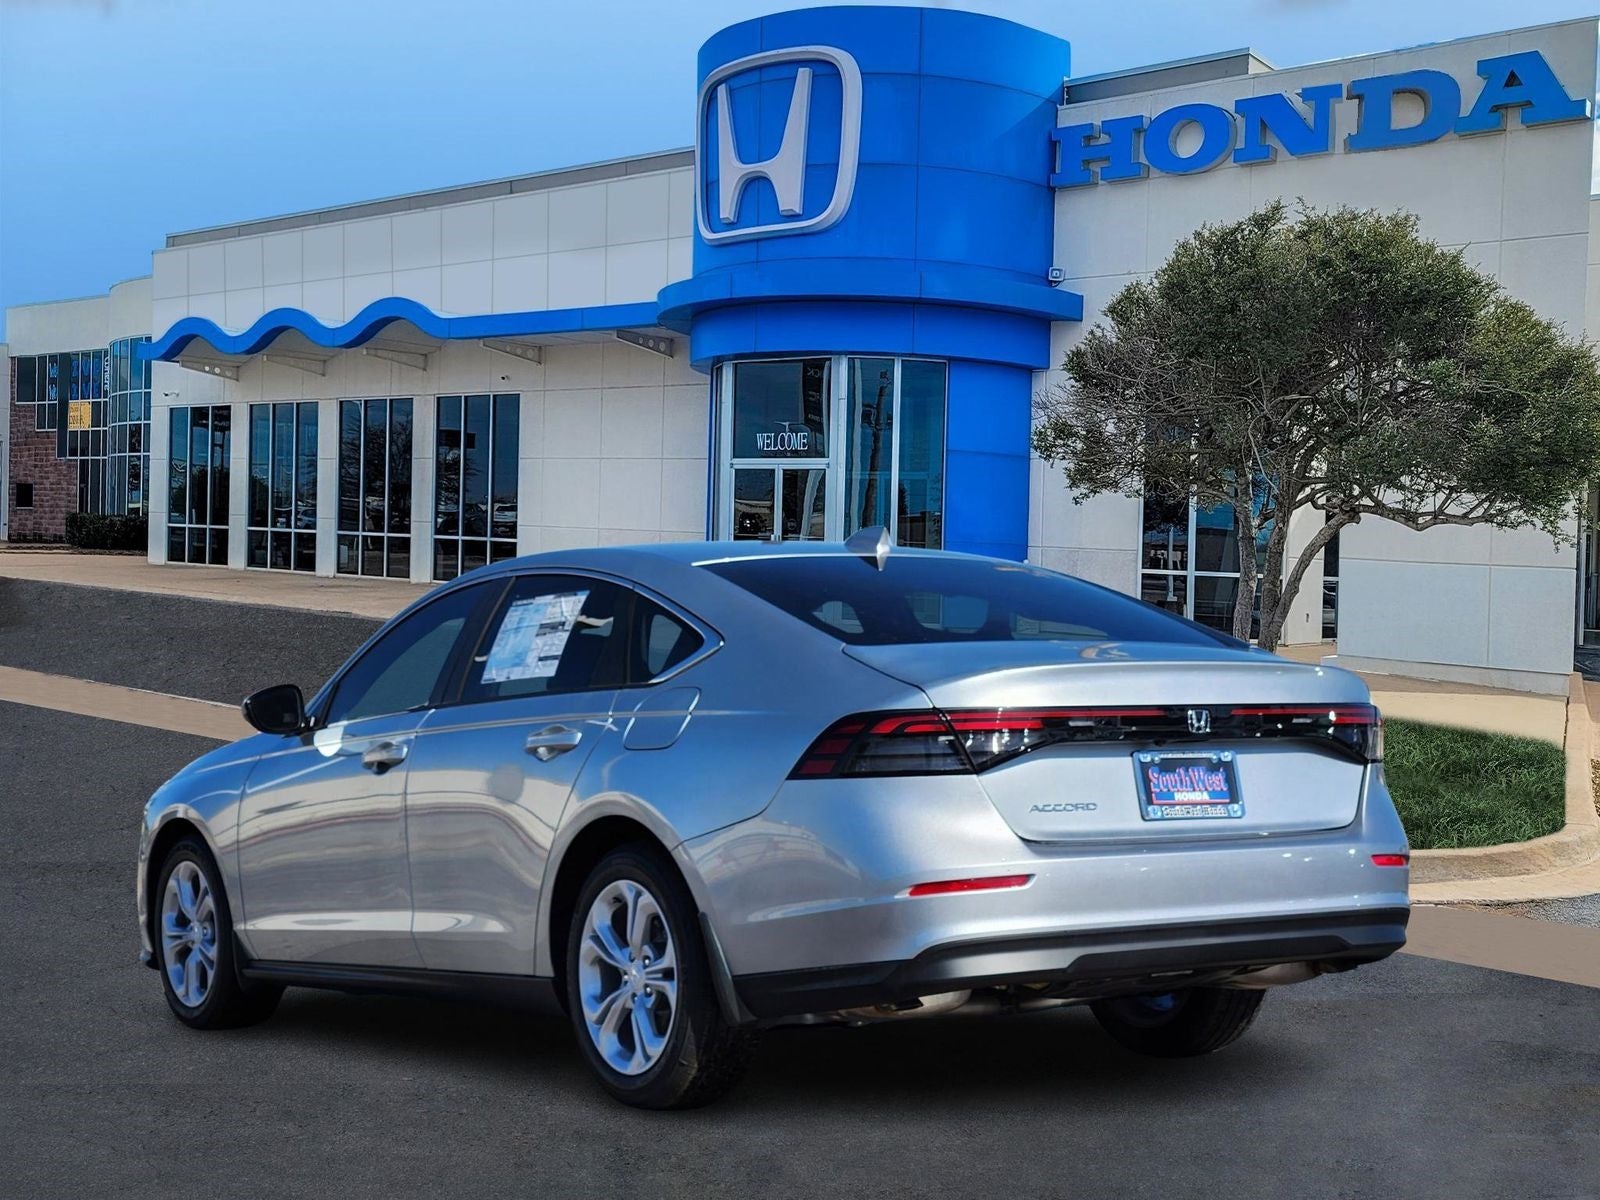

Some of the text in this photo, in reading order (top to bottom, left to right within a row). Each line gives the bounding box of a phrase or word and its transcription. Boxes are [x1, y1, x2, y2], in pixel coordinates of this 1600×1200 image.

[1050, 50, 1592, 189] HONDA
[756, 432, 808, 451] WELCOME
[1174, 791, 1210, 801] HONDA
[1028, 802, 1098, 814] ACCORD
